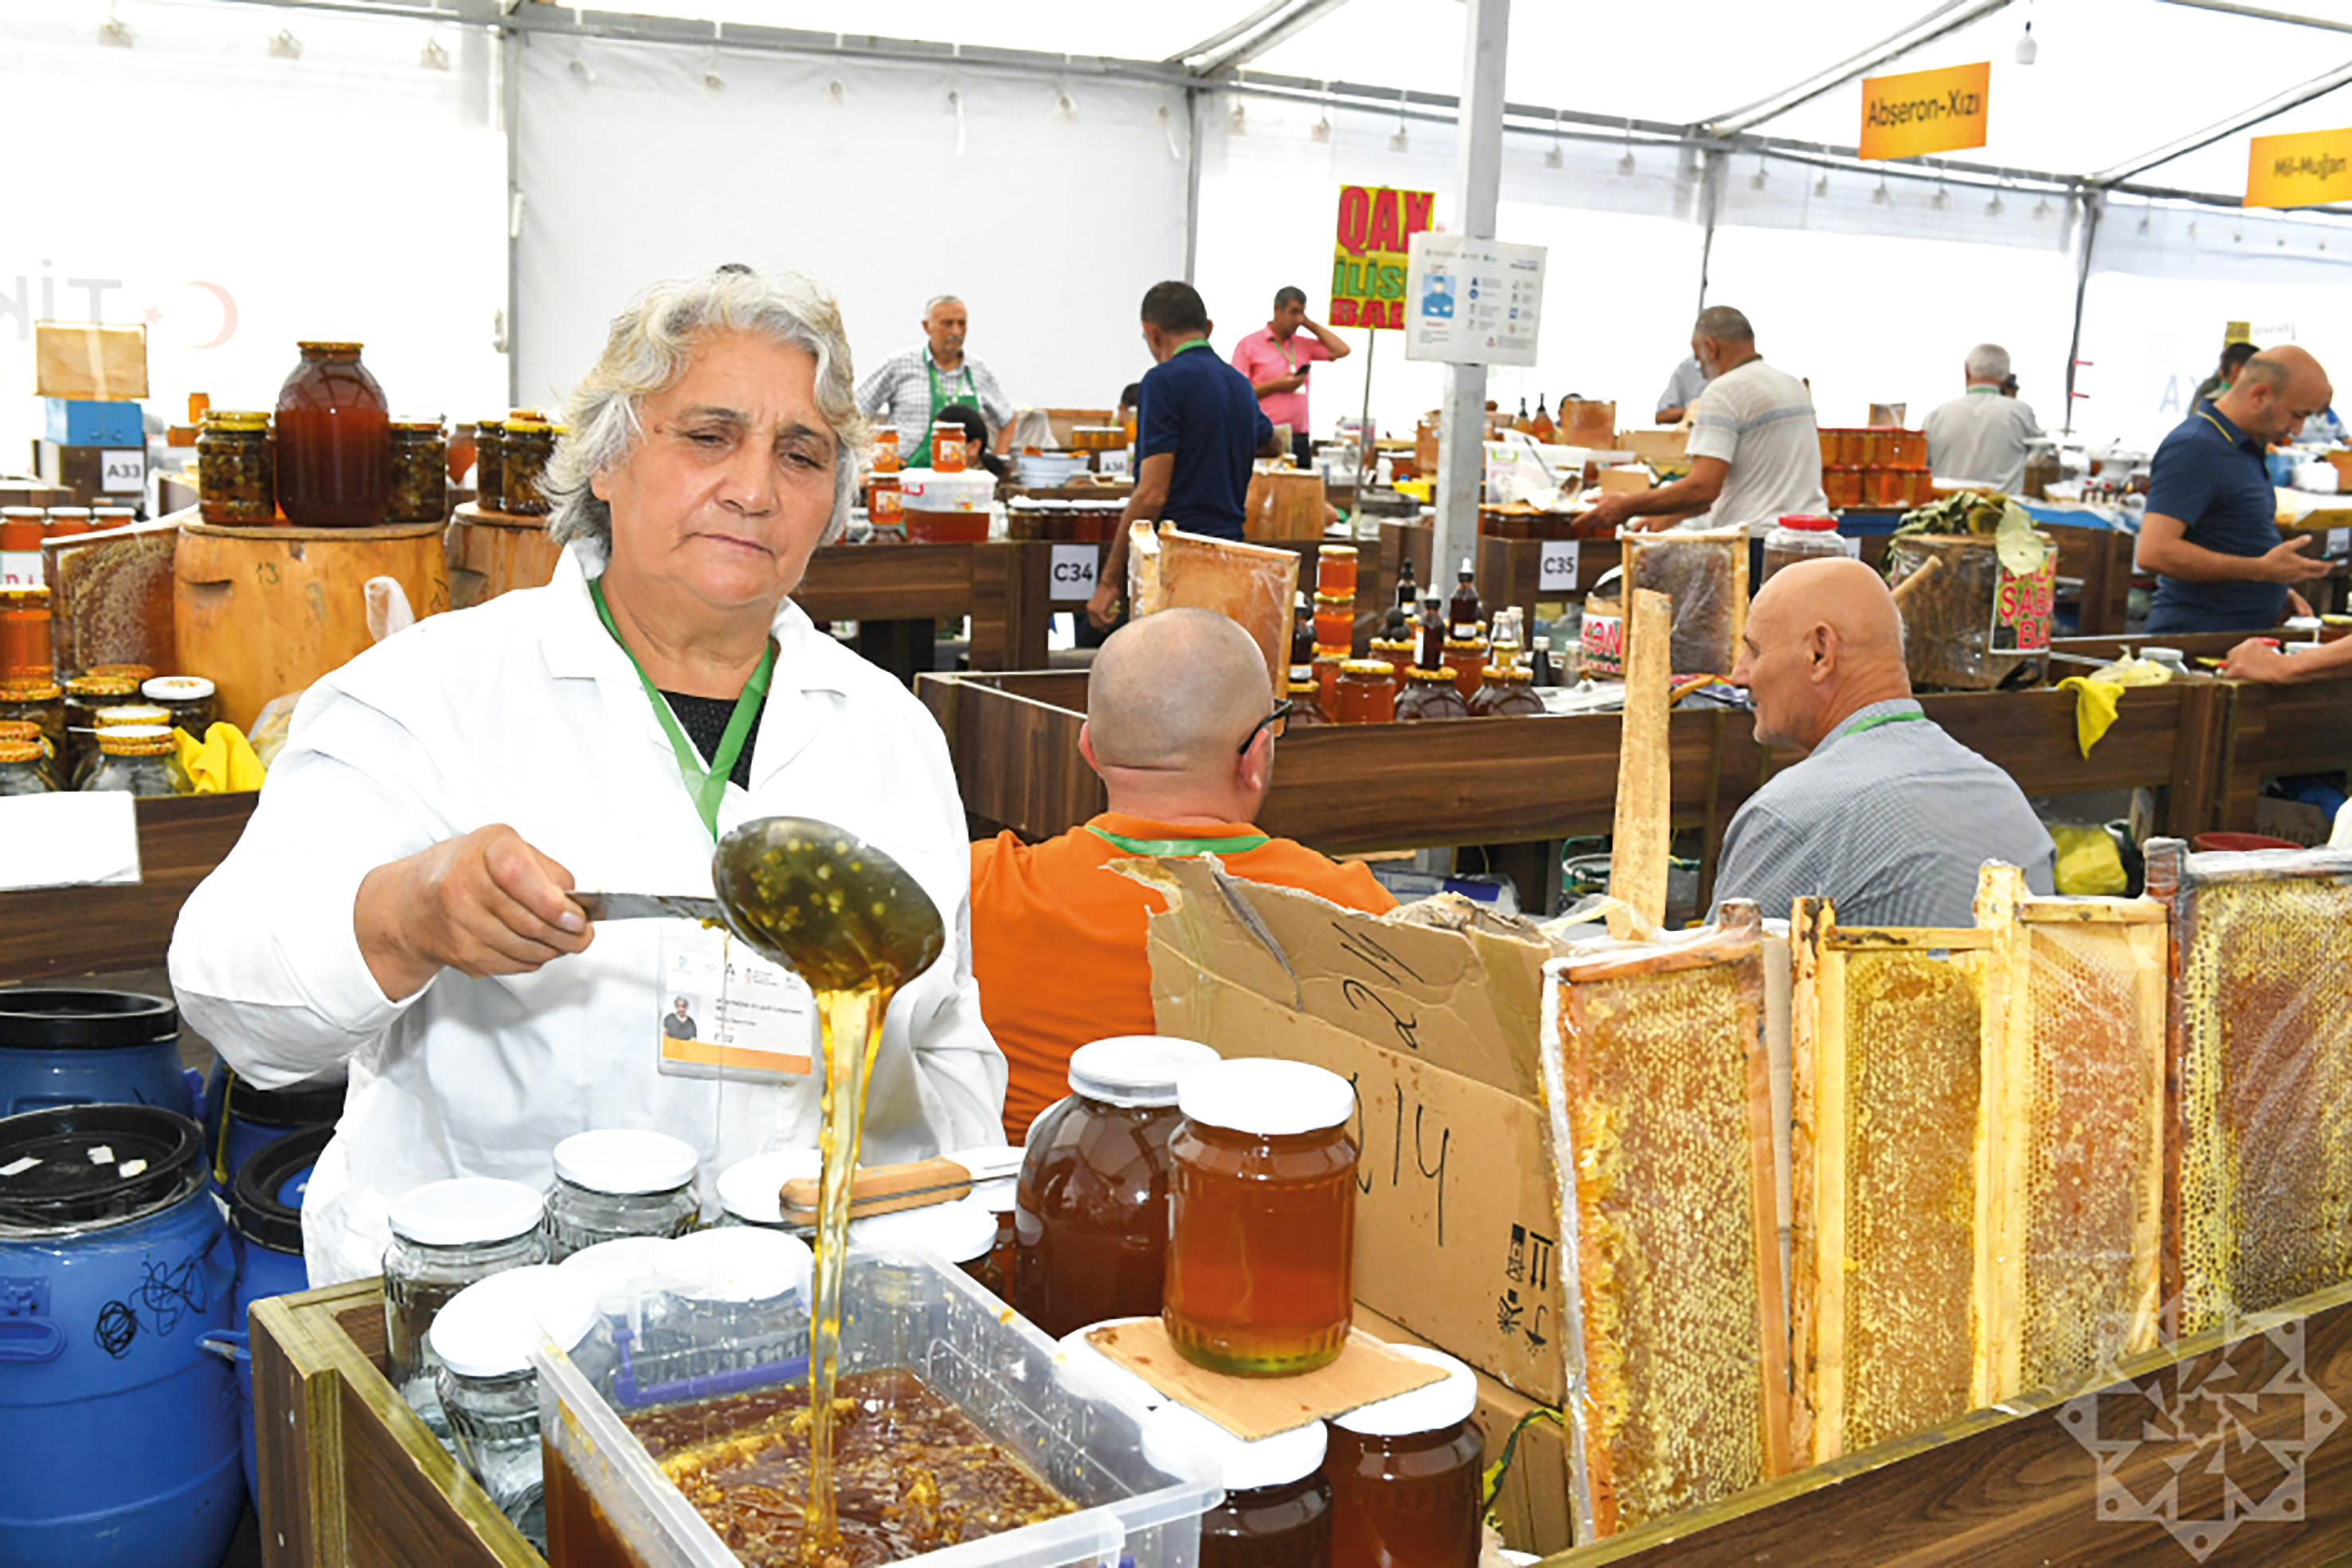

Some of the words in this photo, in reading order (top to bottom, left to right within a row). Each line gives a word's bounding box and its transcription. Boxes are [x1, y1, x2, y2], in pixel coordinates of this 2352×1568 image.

[1867, 89, 1980, 129] Abşeron-Xızı
[1333, 256, 1408, 299] İLİS
[107, 464, 140, 478] A33
[1054, 562, 1094, 582] C34
[1544, 557, 1575, 574] C35
